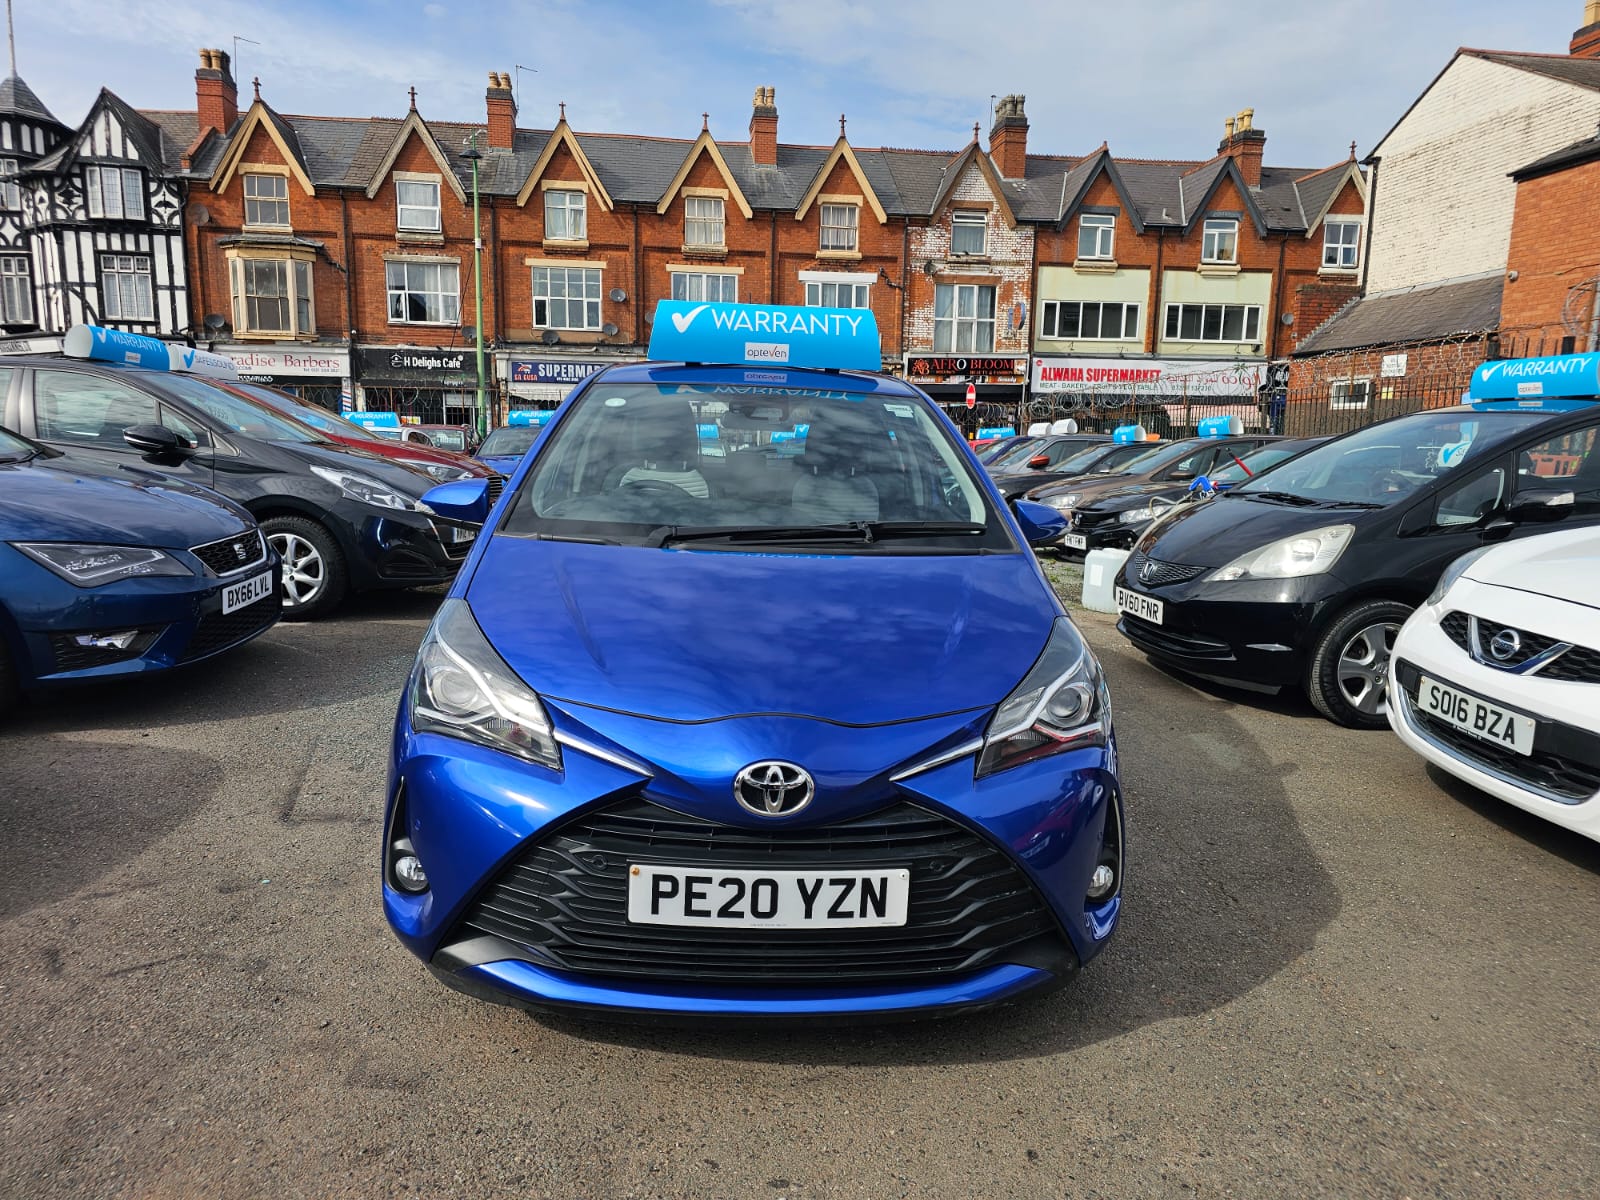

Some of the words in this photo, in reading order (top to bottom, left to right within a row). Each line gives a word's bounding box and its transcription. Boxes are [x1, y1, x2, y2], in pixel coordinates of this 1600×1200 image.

[711, 308, 863, 336] WARRANTY
[111, 333, 163, 352] WARRANTY
[284, 354, 340, 368] Barbers
[404, 357, 411, 367] H
[747, 346, 787, 359] opteven
[538, 363, 603, 378] SUPERMA
[931, 359, 967, 371] AFRO
[970, 359, 1014, 369] BLOOM
[1502, 357, 1593, 377] WARRANTY
[1041, 367, 1083, 382] ALWAHA
[1086, 368, 1161, 383] SUPERMARKET
[227, 582, 252, 608] BX66
[1119, 590, 1139, 612] BV60
[1141, 599, 1158, 621] FNR
[1429, 685, 1469, 723] SO16
[1474, 703, 1515, 744] BZA
[651, 873, 778, 919] PE20
[797, 877, 888, 919] YZN
